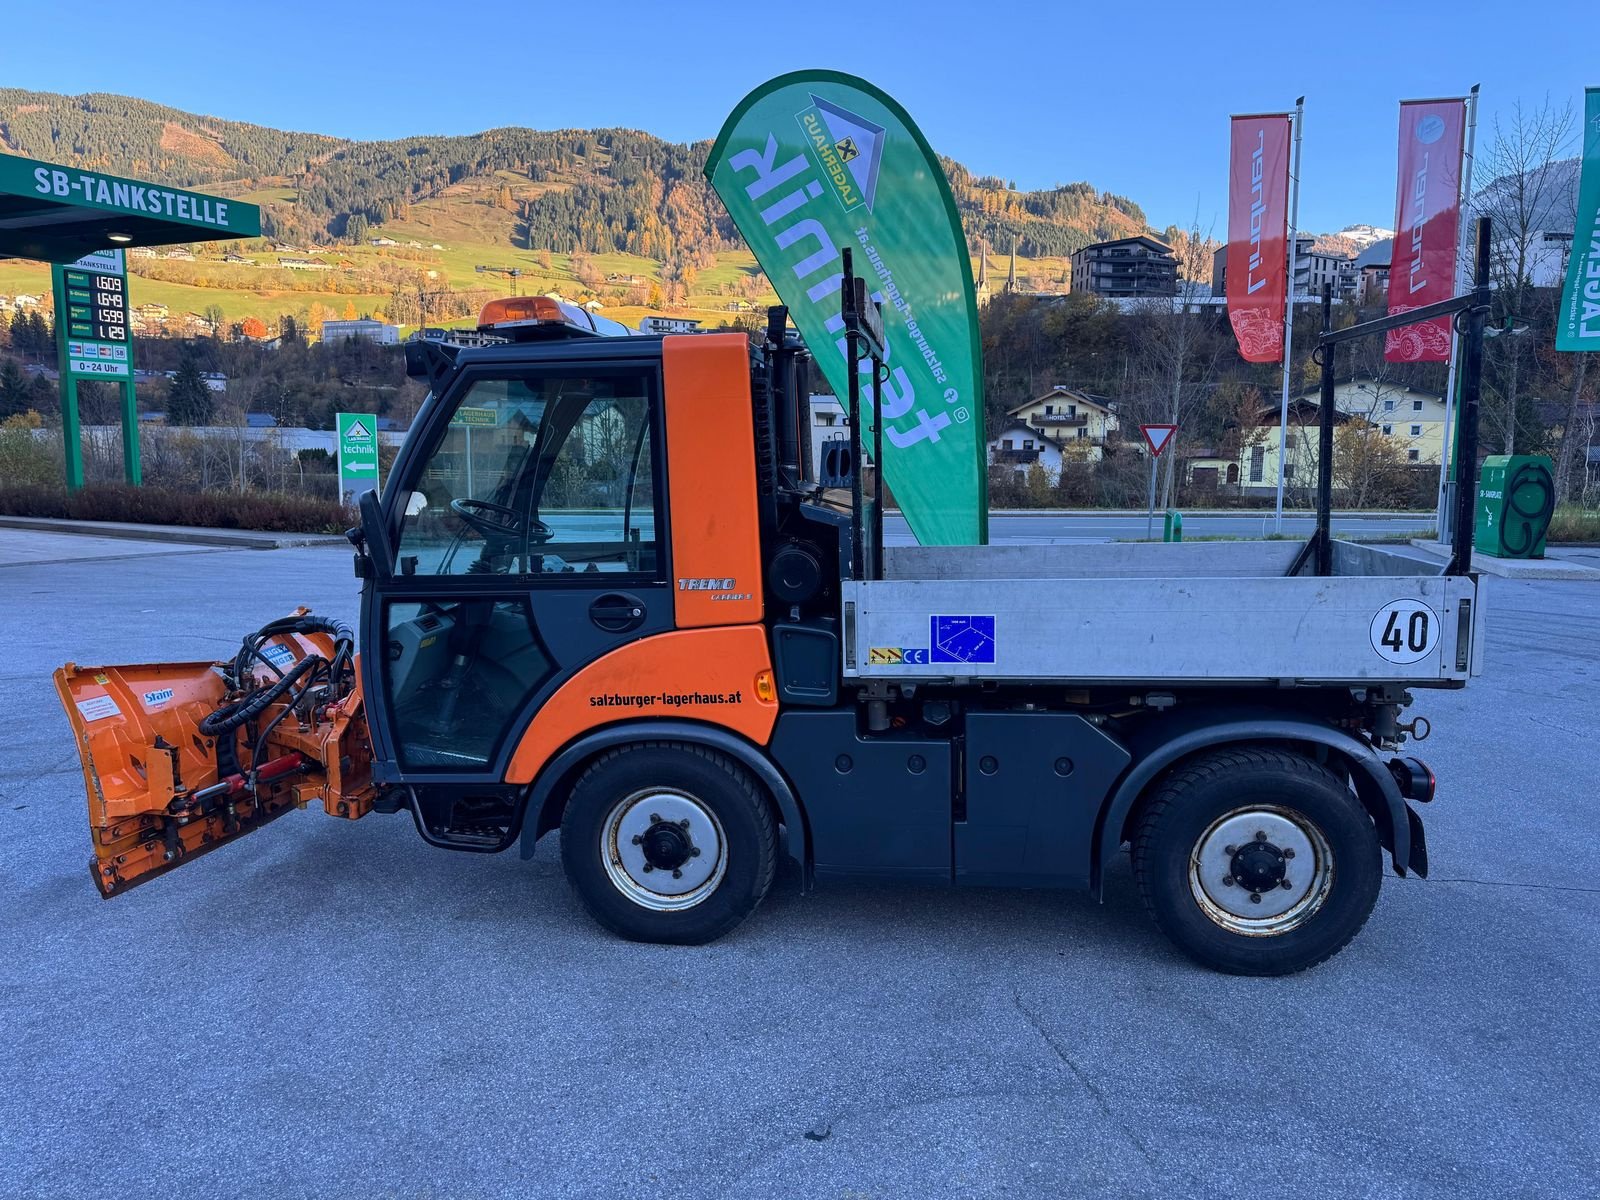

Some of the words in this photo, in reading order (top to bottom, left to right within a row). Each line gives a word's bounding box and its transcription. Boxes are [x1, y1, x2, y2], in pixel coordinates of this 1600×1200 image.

[34, 167, 229, 226] SB-TANKSTELLE
[74, 260, 116, 271] -TANKSTELLE
[80, 362, 85, 370] 0
[92, 363, 102, 371] 24
[105, 364, 118, 373] Uhr
[344, 444, 375, 454] technik
[678, 578, 736, 590] TREMO
[1381, 610, 1429, 653] 40
[590, 691, 742, 708] salzburger-lagerhaus.at
